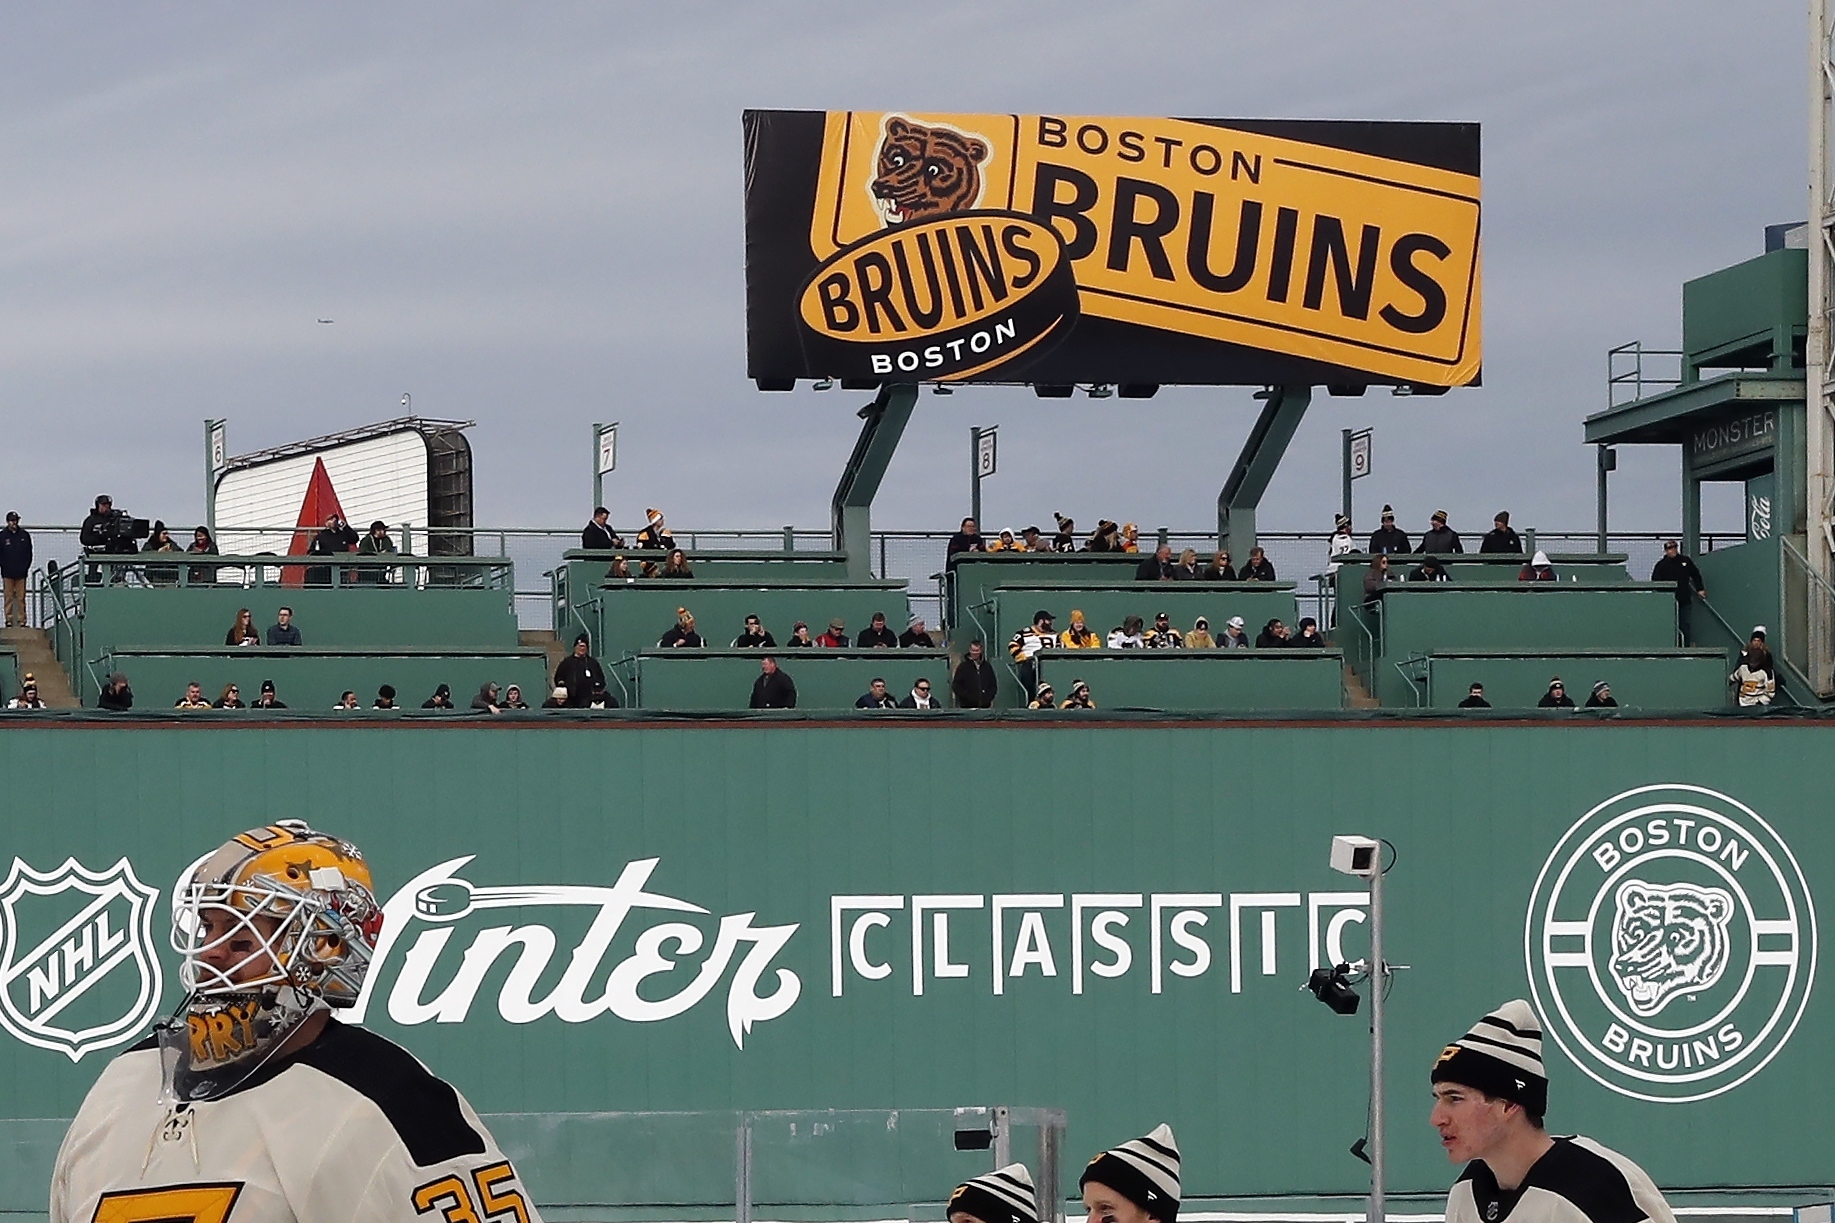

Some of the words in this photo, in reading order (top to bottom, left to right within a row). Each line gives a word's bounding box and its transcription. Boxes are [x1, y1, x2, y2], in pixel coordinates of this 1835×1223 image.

[1037, 117, 1262, 185] BOSTON
[1031, 161, 1453, 333] BRUINS
[818, 224, 1041, 333] BRUINS
[871, 319, 1017, 374] BOSTON
[215, 446, 221, 462] 6
[603, 450, 611, 466] 7
[1694, 411, 1774, 453] MONSTER
[982, 453, 990, 470] 8
[1355, 454, 1364, 472] 9
[1592, 818, 1750, 872] BOSTON
[27, 909, 126, 1014] NHL
[847, 904, 1370, 983] CLASSIC
[1601, 1023, 1744, 1069] BRUINS
